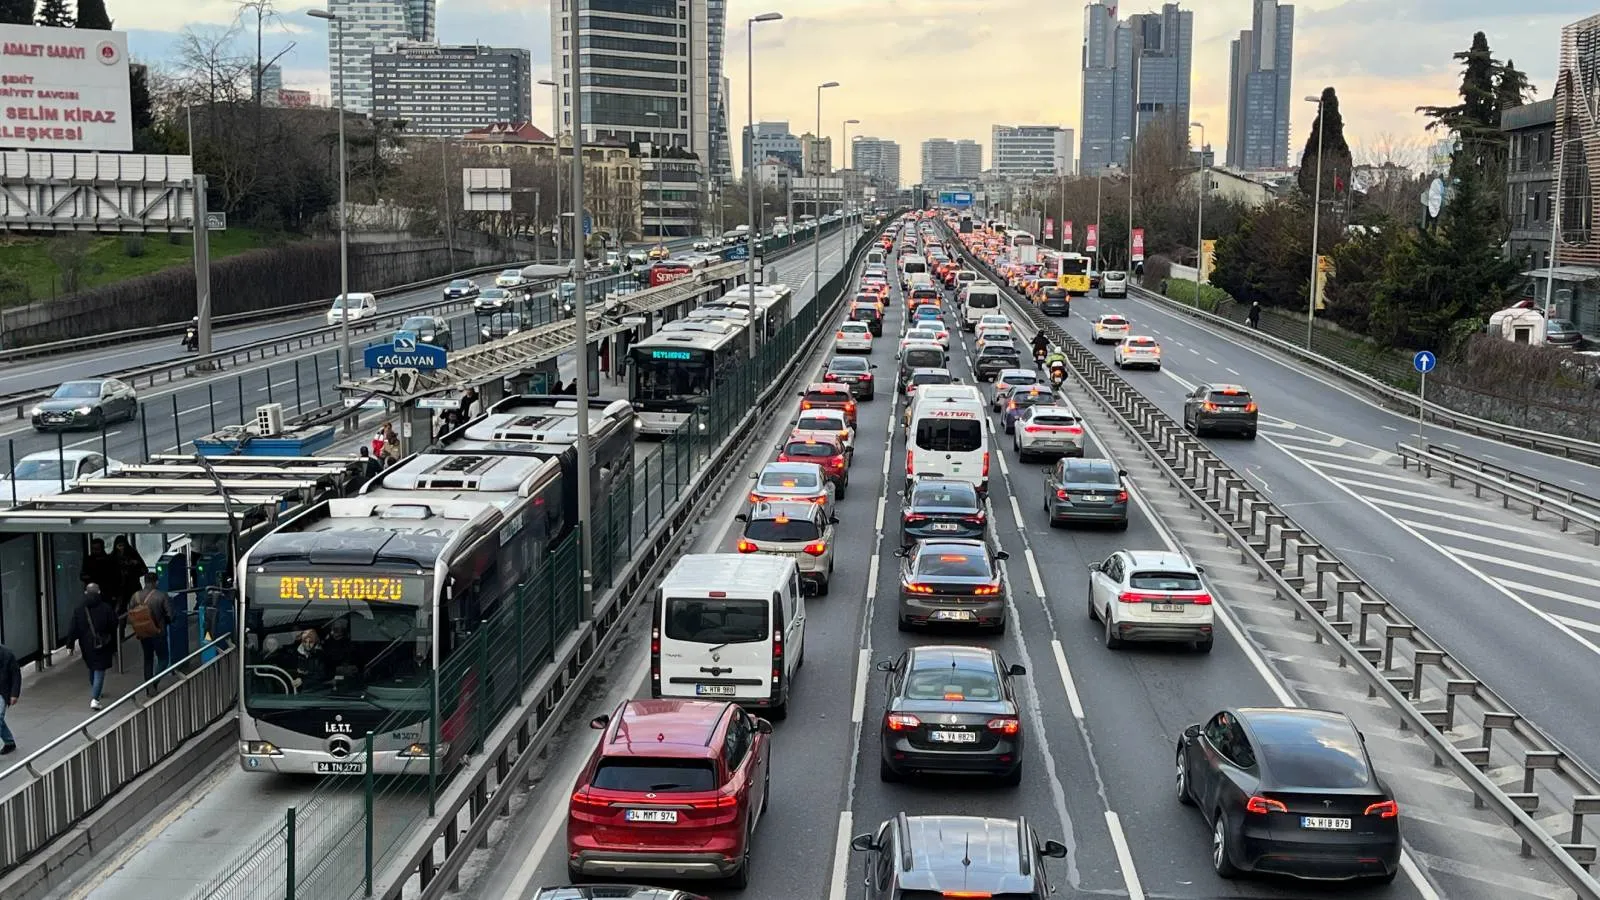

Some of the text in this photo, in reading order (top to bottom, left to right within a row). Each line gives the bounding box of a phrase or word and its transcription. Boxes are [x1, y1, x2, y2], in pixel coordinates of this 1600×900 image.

[3, 42, 85, 60] ADALET SARAYI
[6, 105, 116, 123] SELİM KİRAZ
[0, 125, 82, 141] LEŞKESİ
[377, 355, 434, 367] ÇAĞLAYAN
[936, 732, 945, 740] 34
[319, 762, 329, 771] 34
[332, 762, 343, 771] TN
[630, 810, 640, 820] 34
[661, 811, 675, 821] 974
[1307, 818, 1316, 827] 34
